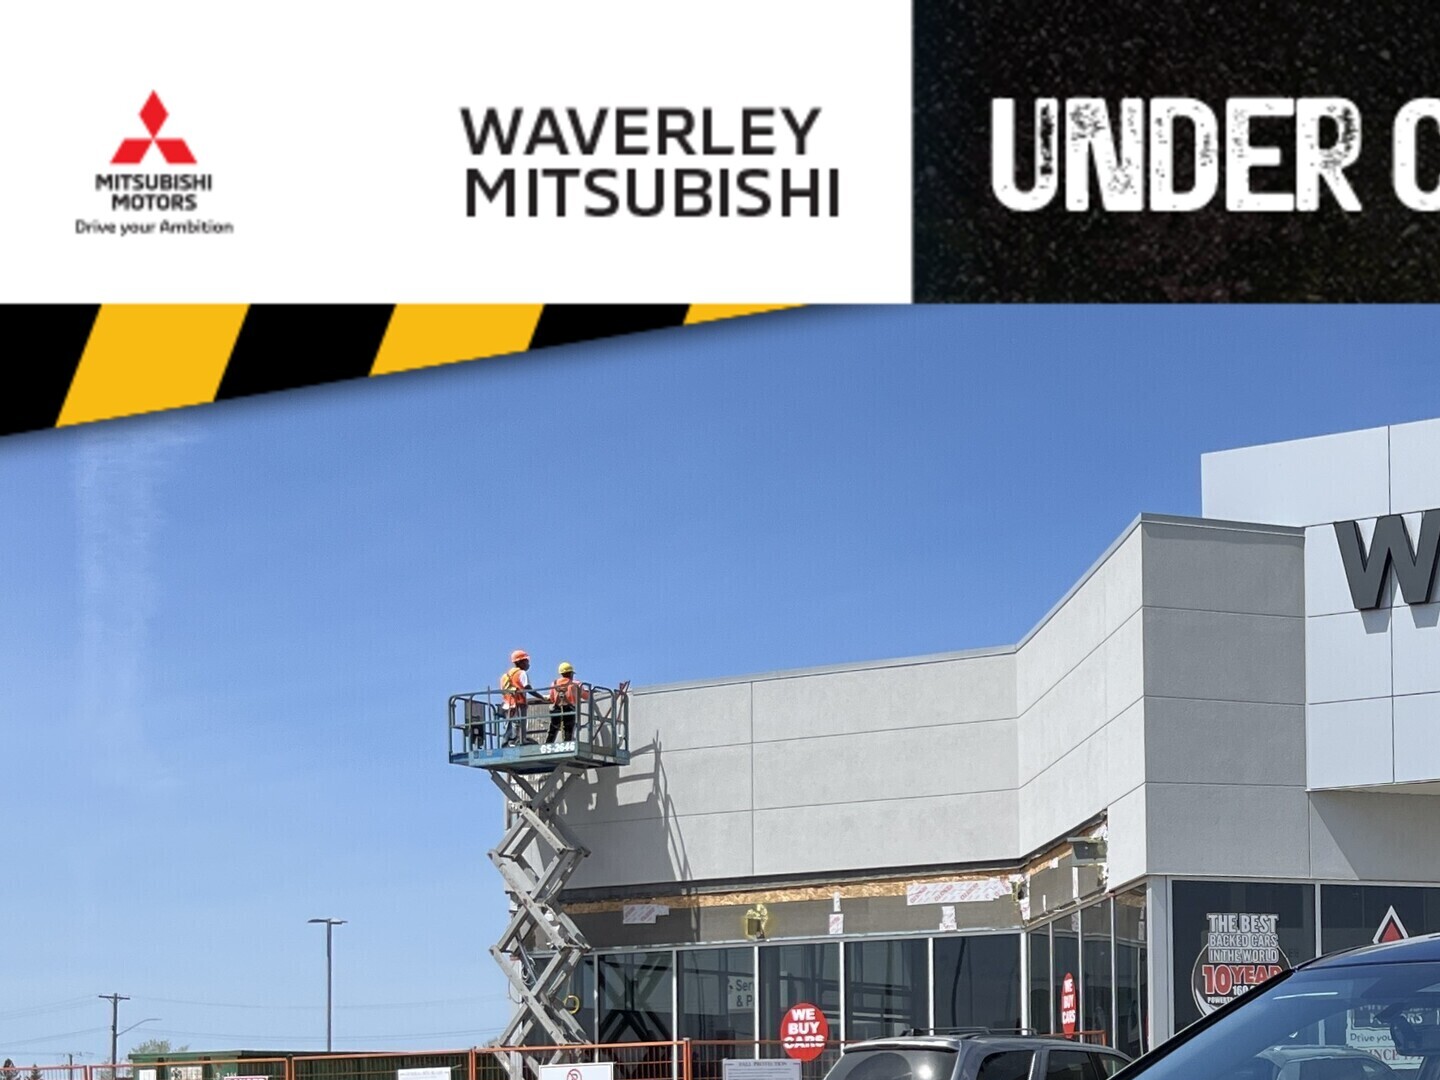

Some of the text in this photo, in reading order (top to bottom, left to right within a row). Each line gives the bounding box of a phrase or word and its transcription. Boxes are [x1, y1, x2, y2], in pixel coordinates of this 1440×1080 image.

[540, 741, 576, 754] GS-2646
[1207, 914, 1279, 934] THE BEST
[1209, 934, 1279, 948] BACKED CARS
[1209, 948, 1279, 962] IN THE WORLD
[736, 980, 754, 991] Ser
[1202, 964, 1232, 995] 10
[791, 1008, 816, 1021] WE
[787, 1022, 820, 1035] BUY
[783, 1035, 825, 1048] CARS
[1350, 1033, 1392, 1044] Drive you
